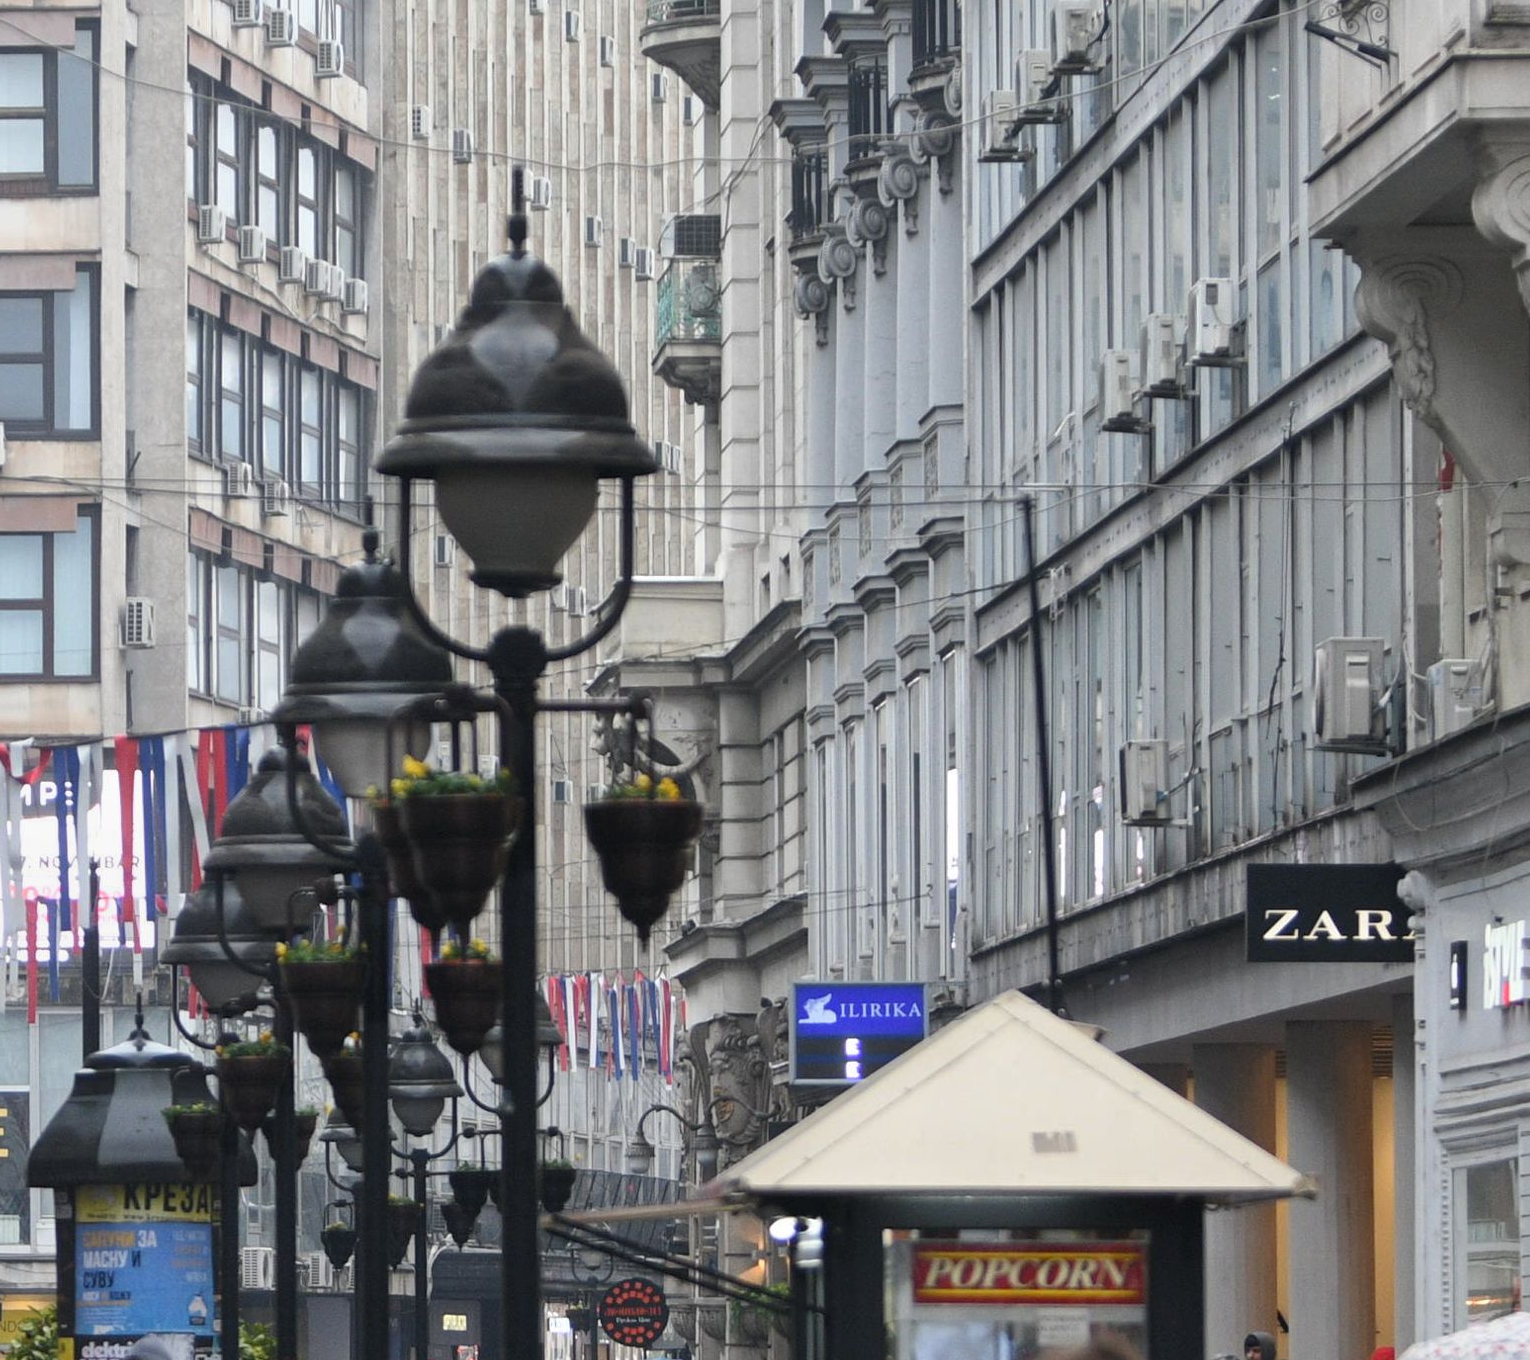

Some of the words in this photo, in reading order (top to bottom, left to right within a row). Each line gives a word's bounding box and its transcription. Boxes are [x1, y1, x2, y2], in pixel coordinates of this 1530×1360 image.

[840, 1002, 922, 1018] ILIRIKA
[83, 1271, 115, 1288] СУВУ
[923, 1256, 1131, 1289] POPCORN
